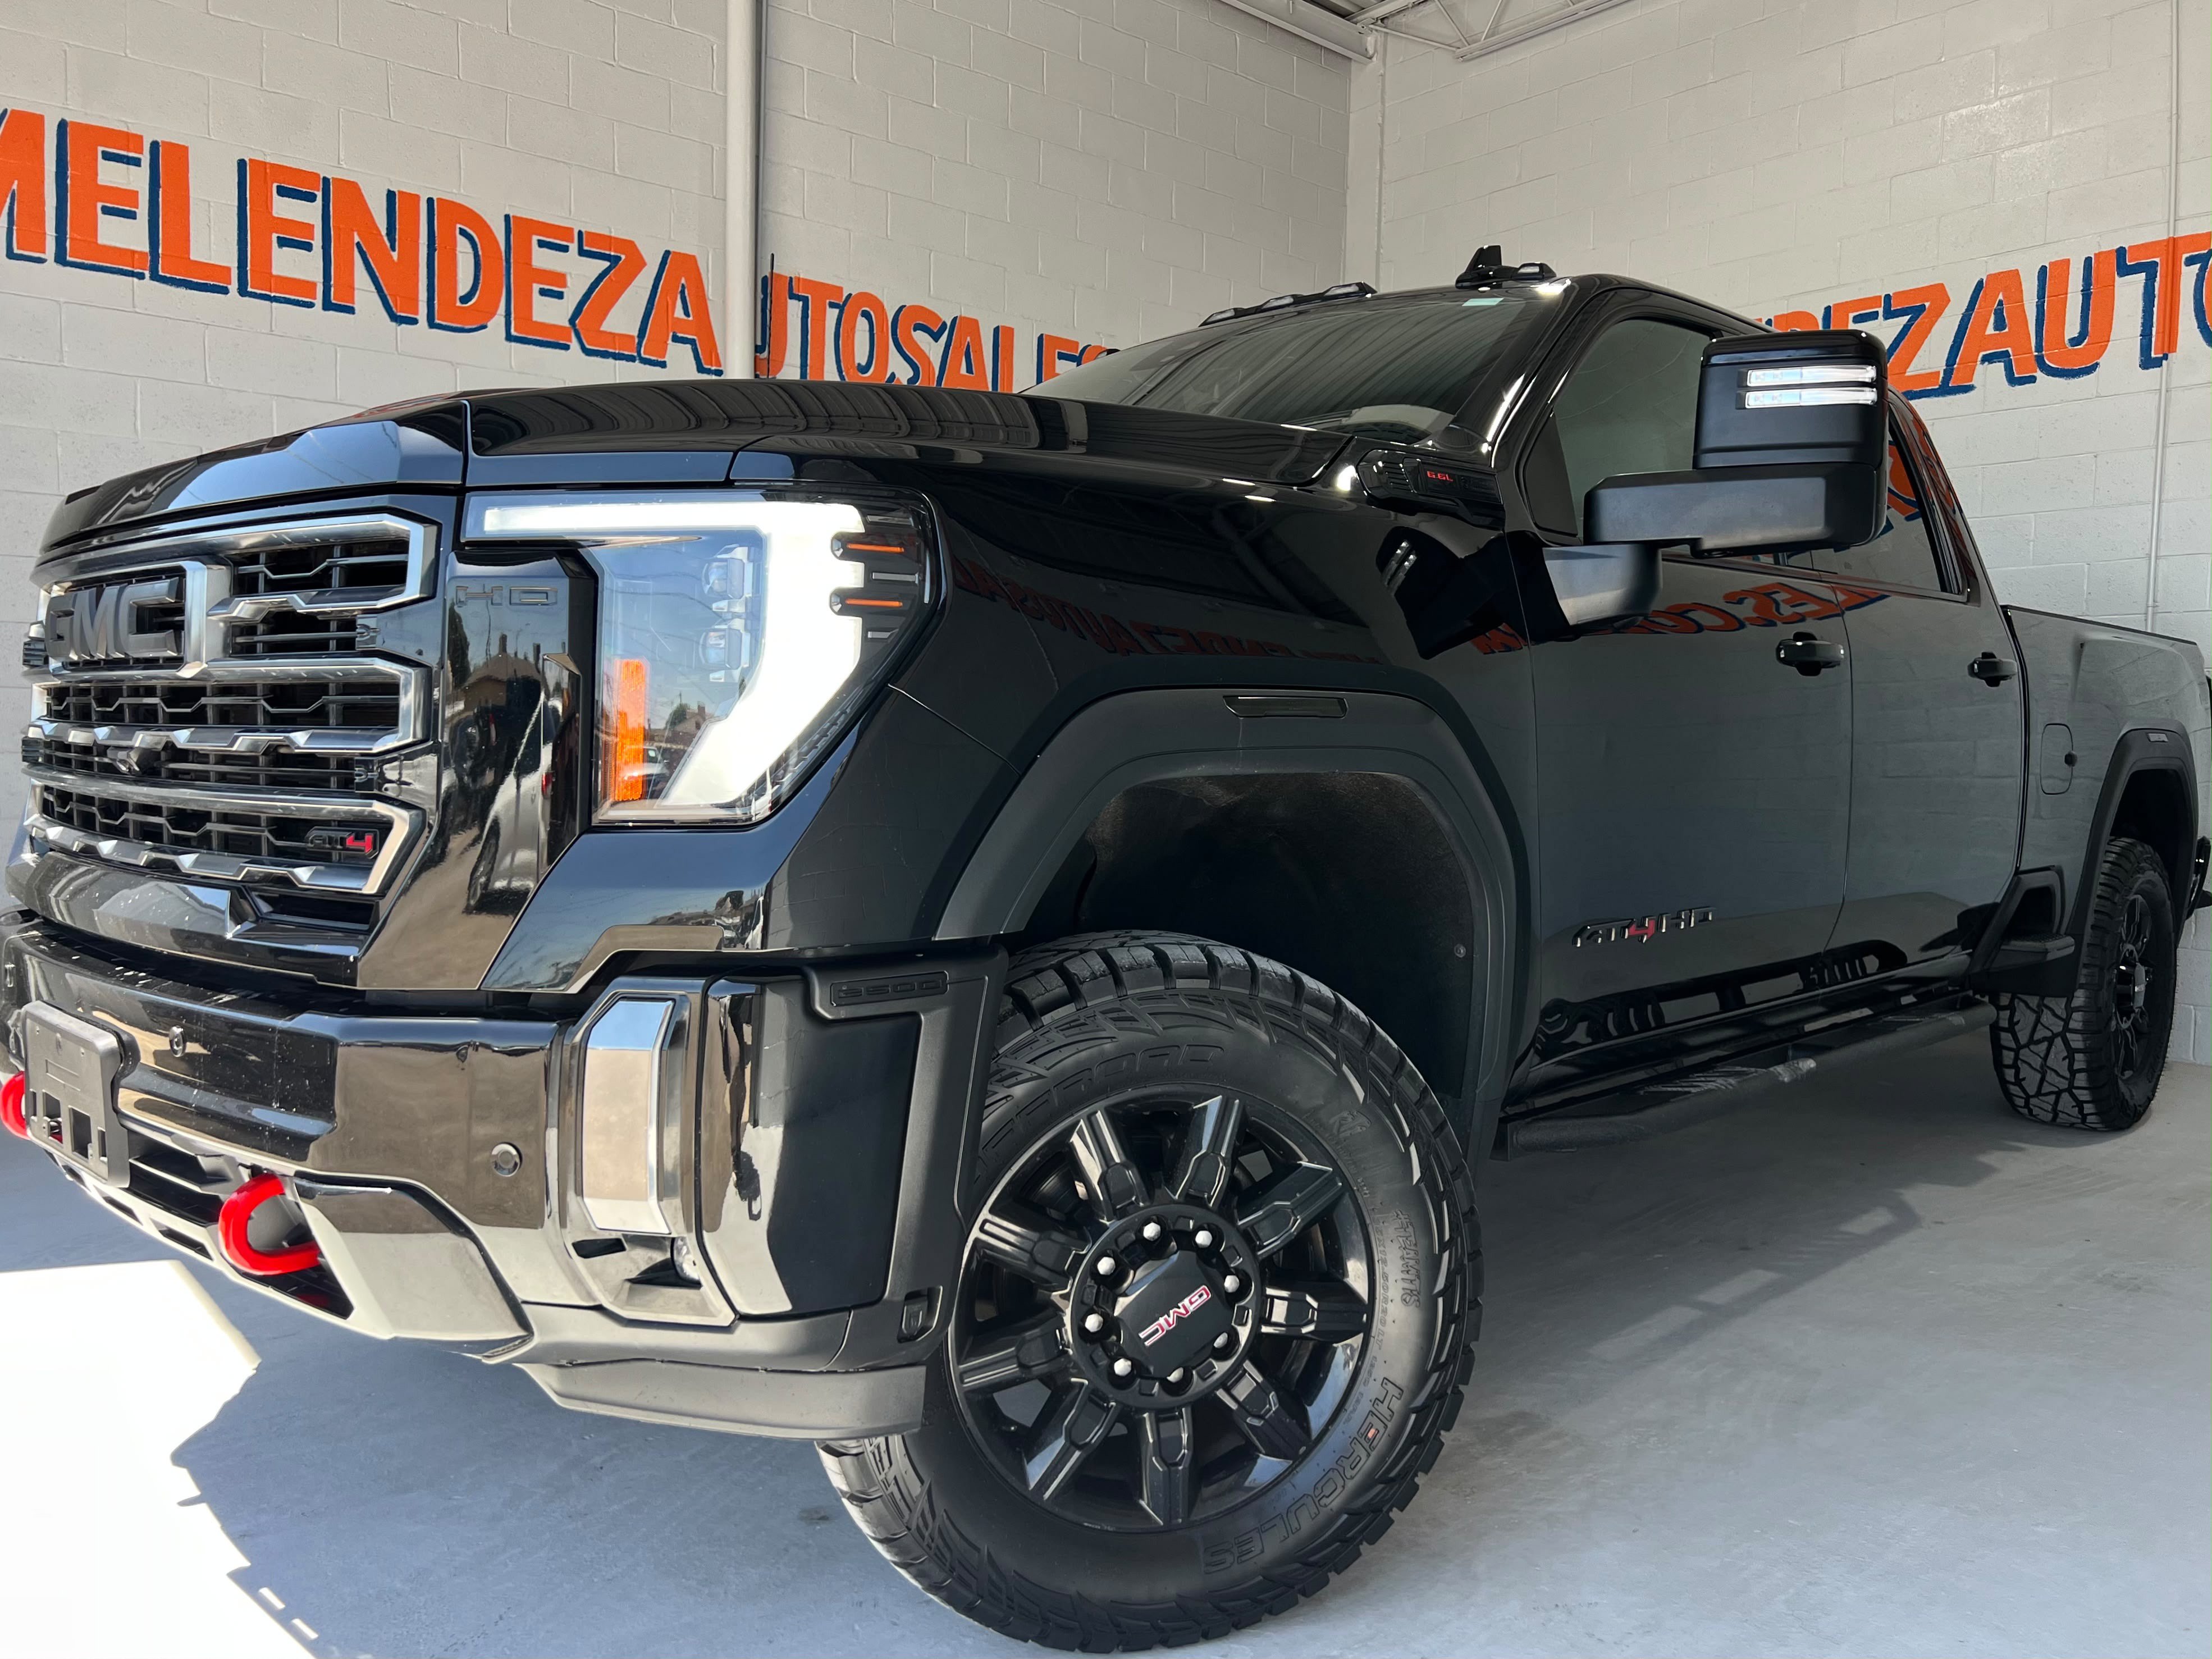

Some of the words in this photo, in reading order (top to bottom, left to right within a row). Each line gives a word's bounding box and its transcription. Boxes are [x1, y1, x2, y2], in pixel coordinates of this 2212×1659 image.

[1427, 470, 1453, 482] 6.6L
[45, 577, 180, 661] GMC
[455, 586, 558, 607] HD
[307, 829, 376, 856] AT4
[1137, 1283, 1213, 1348] GMC
[1203, 1376, 1405, 1575] HERCULES
